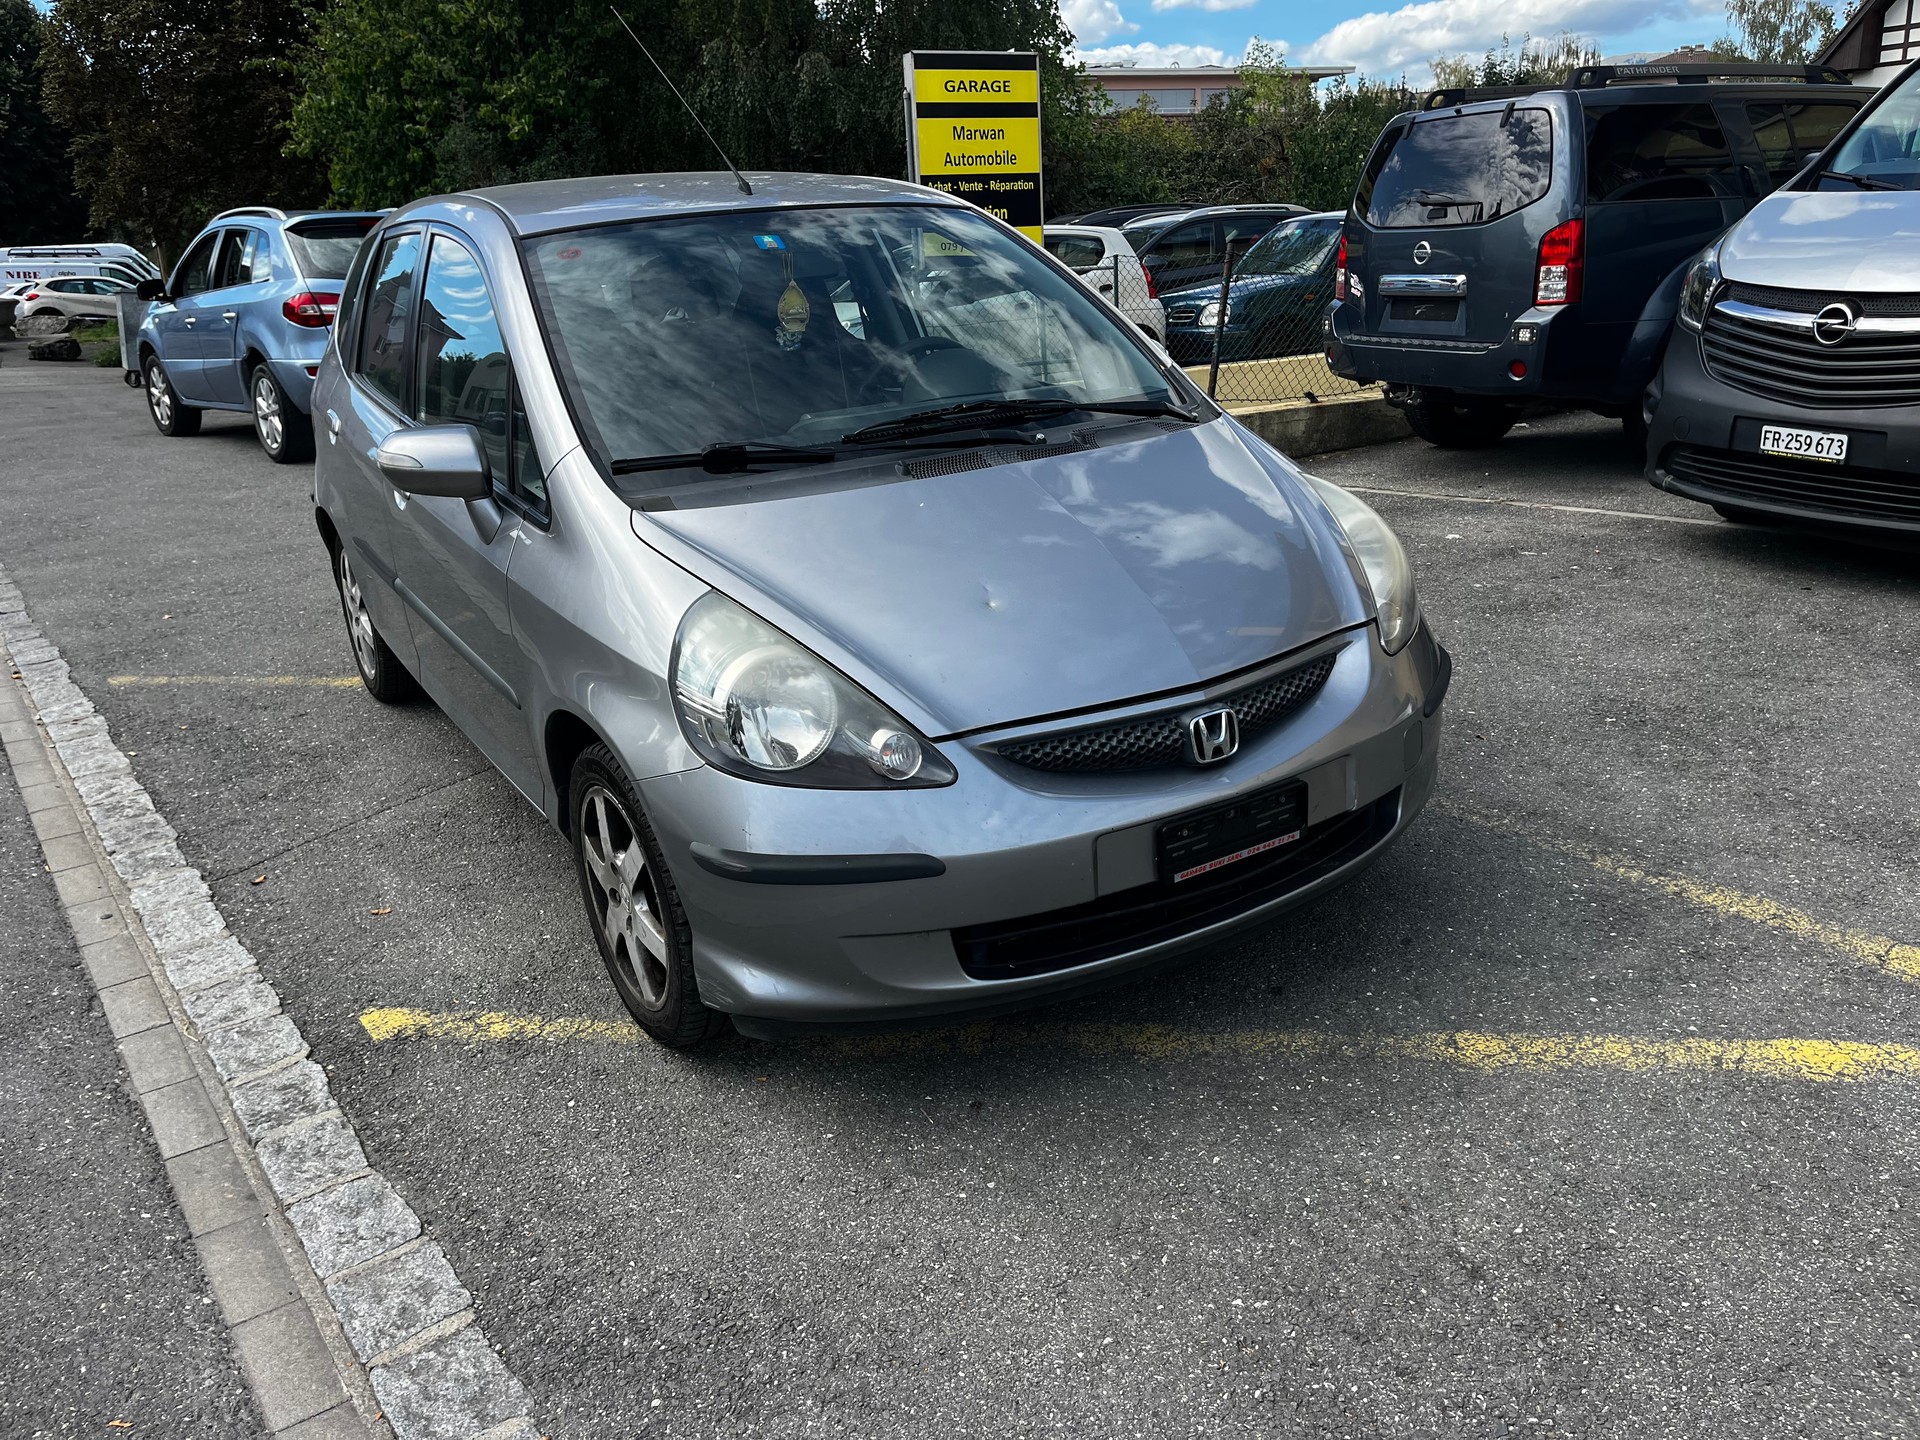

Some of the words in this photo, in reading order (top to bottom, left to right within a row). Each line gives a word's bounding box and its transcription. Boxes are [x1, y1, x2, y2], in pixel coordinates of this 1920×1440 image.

[1616, 65, 1680, 75] PATHFINDER
[944, 80, 1012, 93] GARAGE
[952, 125, 1005, 141] Marwan
[944, 151, 1017, 167] Automobile
[927, 180, 952, 192] Achat
[958, 181, 983, 192] Vente
[990, 179, 1034, 193] Réparation
[5, 270, 41, 279] NIBE
[1180, 865, 1207, 879] GARAGE
